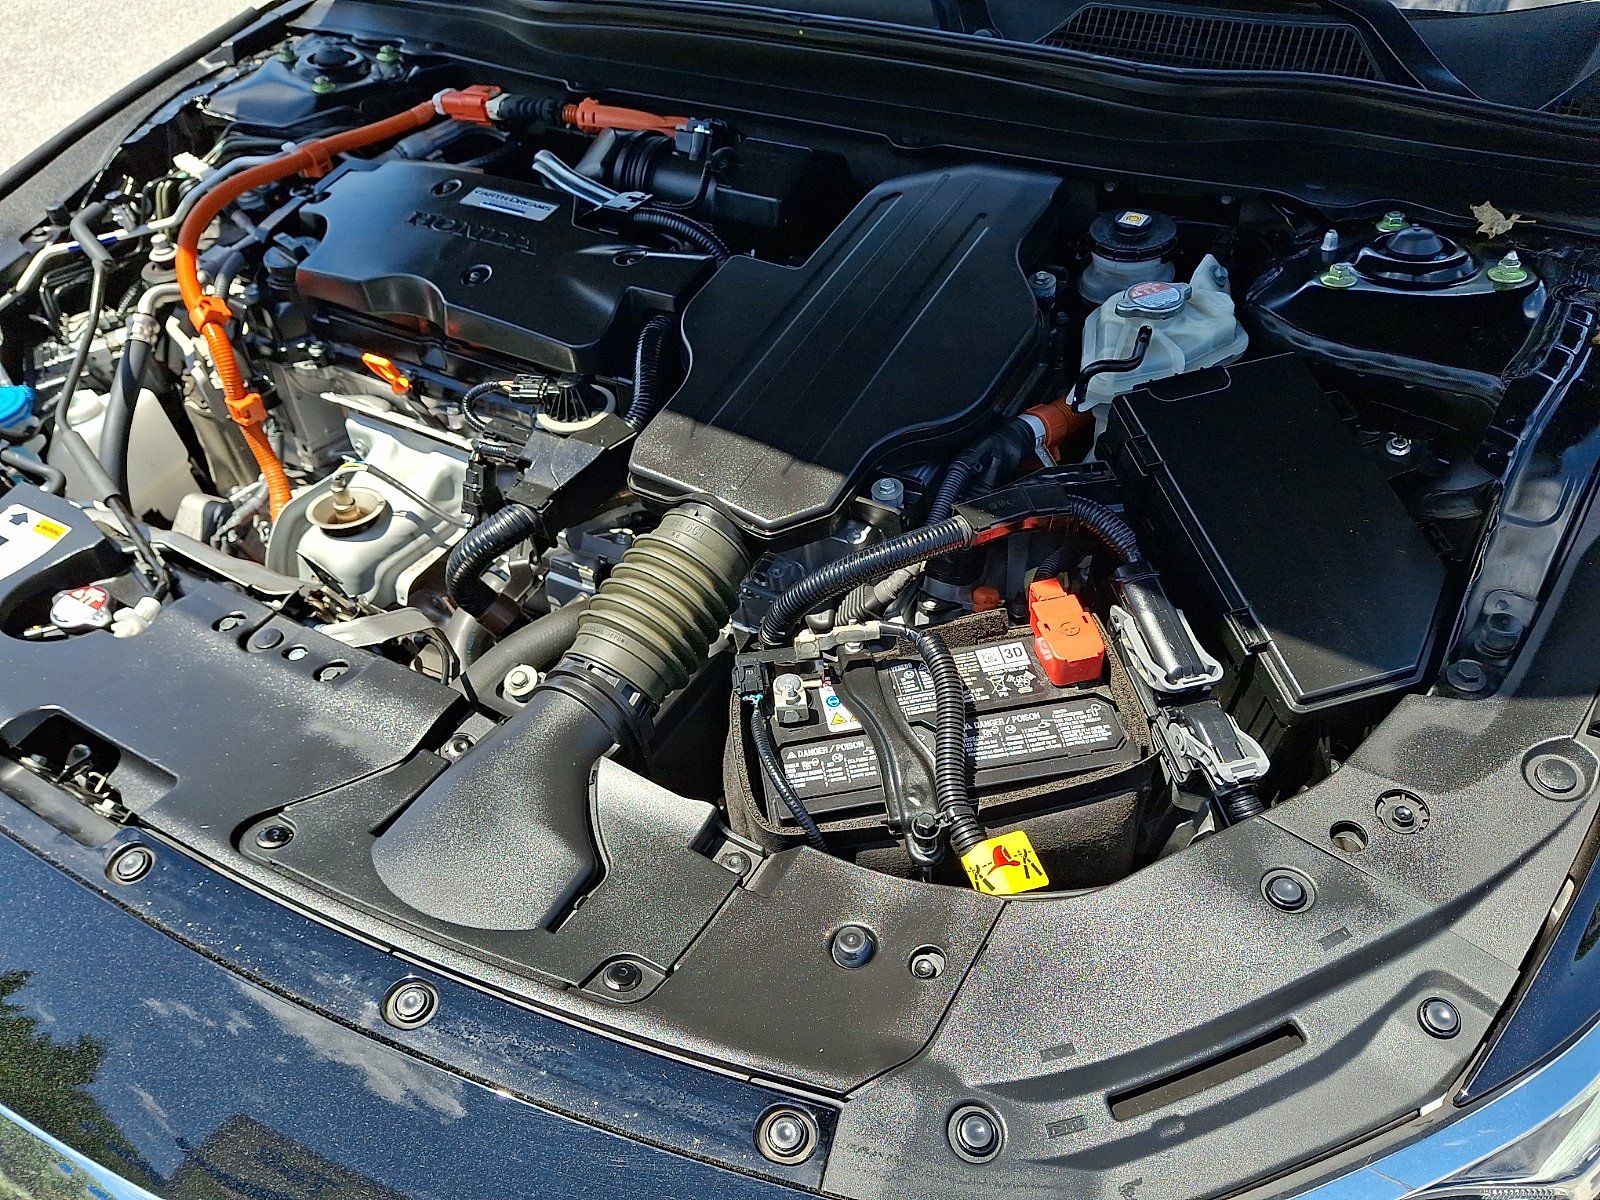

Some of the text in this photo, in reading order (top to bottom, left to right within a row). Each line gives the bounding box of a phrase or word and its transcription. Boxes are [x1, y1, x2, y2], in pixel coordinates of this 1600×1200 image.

[406, 210, 537, 255] HONDA
[1004, 646, 1023, 659] 3D
[973, 717, 1006, 729] DANGER
[1012, 711, 1041, 724] POISON
[797, 745, 829, 758] DANGER
[835, 739, 865, 754] POISON
